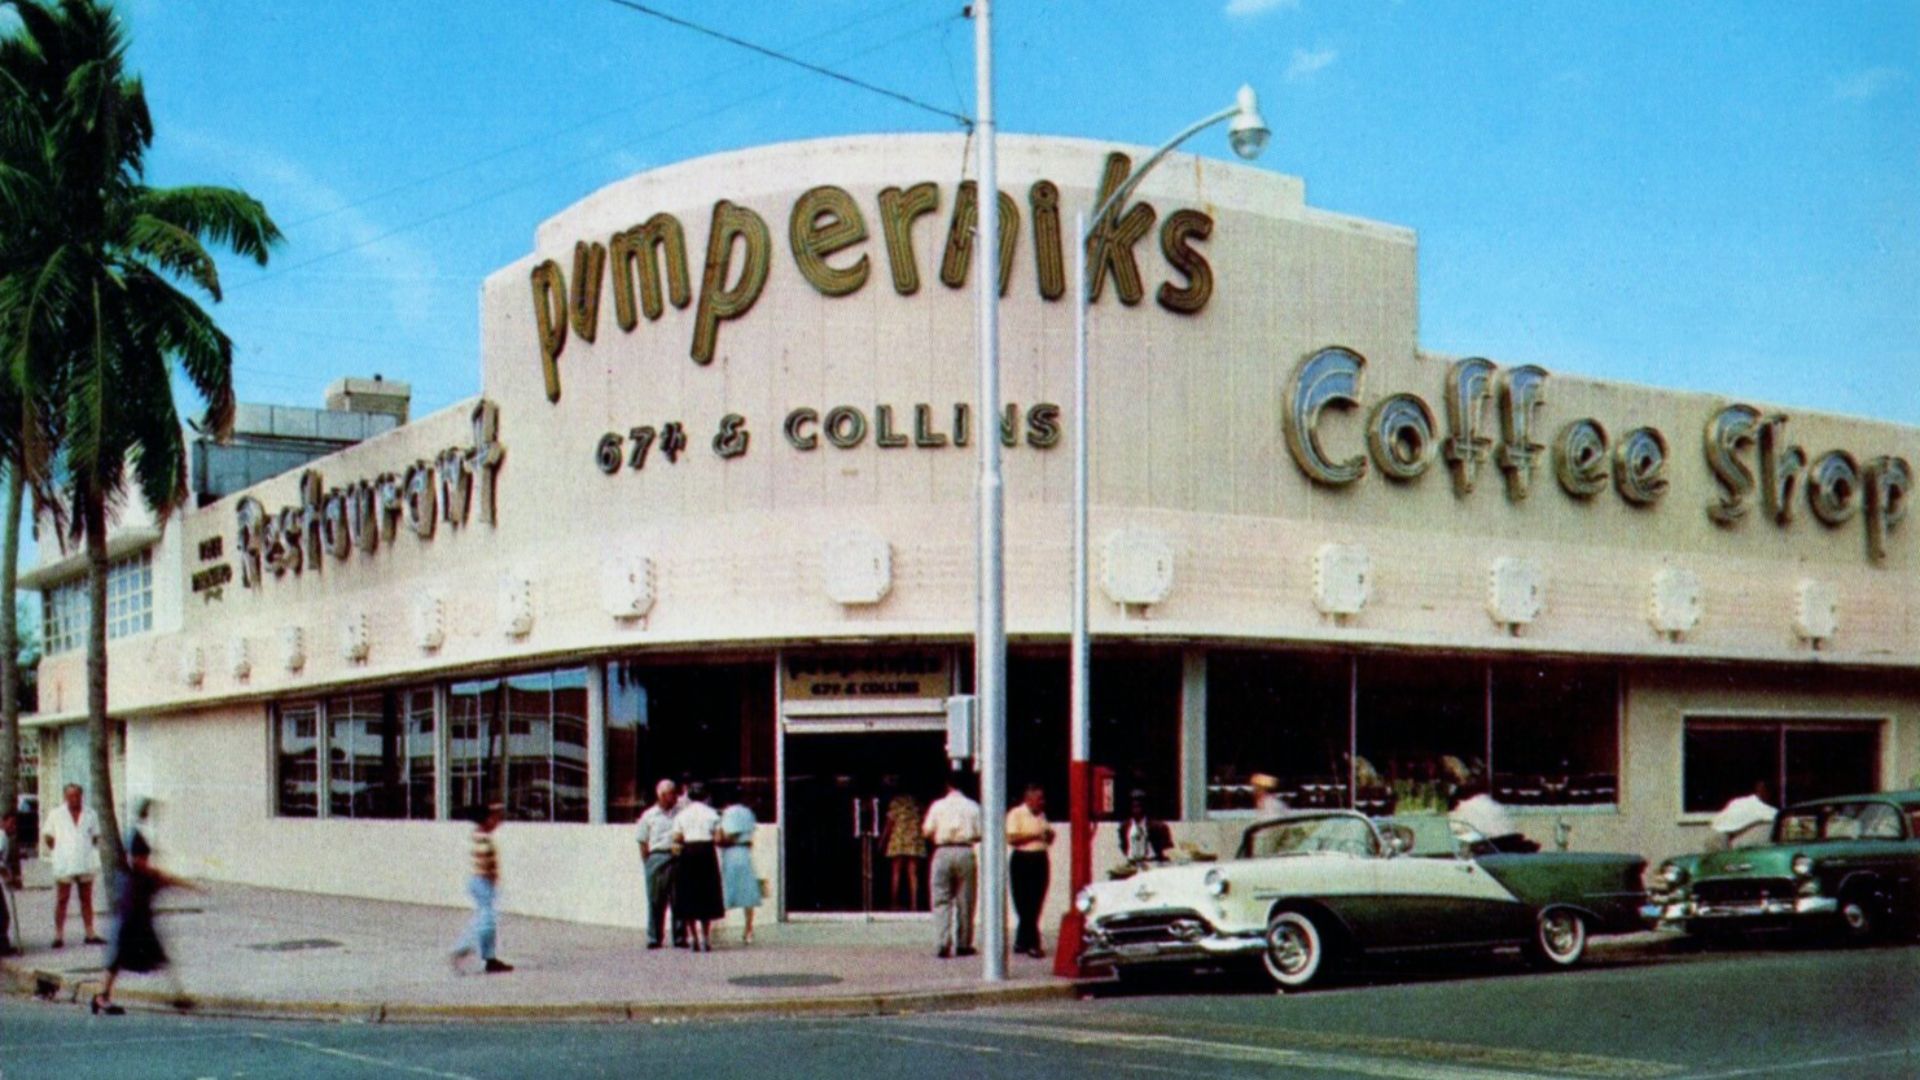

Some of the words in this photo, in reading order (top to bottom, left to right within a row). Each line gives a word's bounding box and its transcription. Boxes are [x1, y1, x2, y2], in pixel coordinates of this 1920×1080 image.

[236, 398, 507, 590] Restaurant
[712, 413, 750, 459] &
[1282, 345, 1671, 505] Coffee
[1704, 403, 1915, 566] Shop
